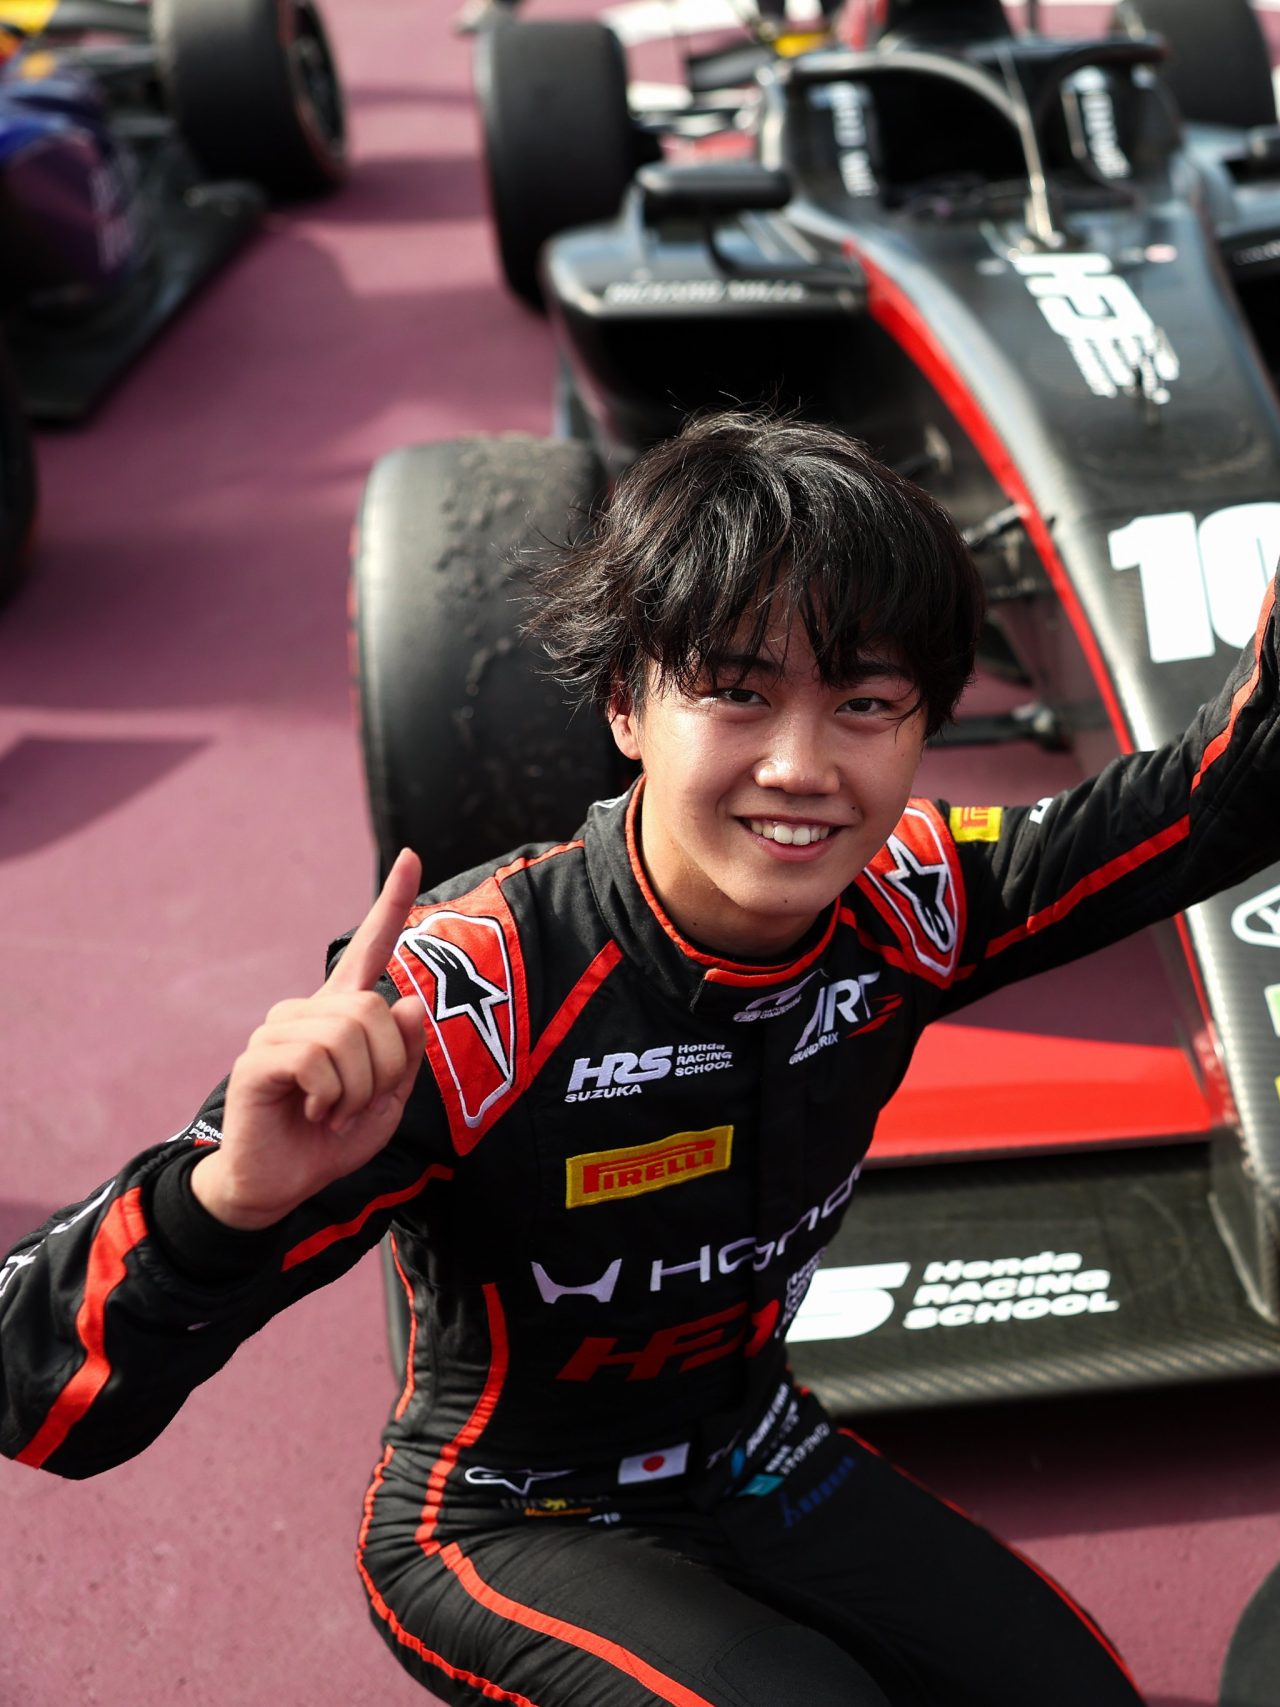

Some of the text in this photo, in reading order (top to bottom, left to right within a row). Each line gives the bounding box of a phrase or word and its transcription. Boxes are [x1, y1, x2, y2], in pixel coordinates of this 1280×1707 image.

[676, 1052, 733, 1066] RACING
[678, 1043, 725, 1054] Honda
[567, 1046, 673, 1093] HRS
[674, 1061, 734, 1077] SCHOOL
[564, 1084, 642, 1103] SUZUKA
[583, 1139, 716, 1195] PIRELLI
[923, 1251, 1083, 1283] Honda
[913, 1269, 1112, 1306] RACING
[902, 1292, 1121, 1330] SCHOOL
